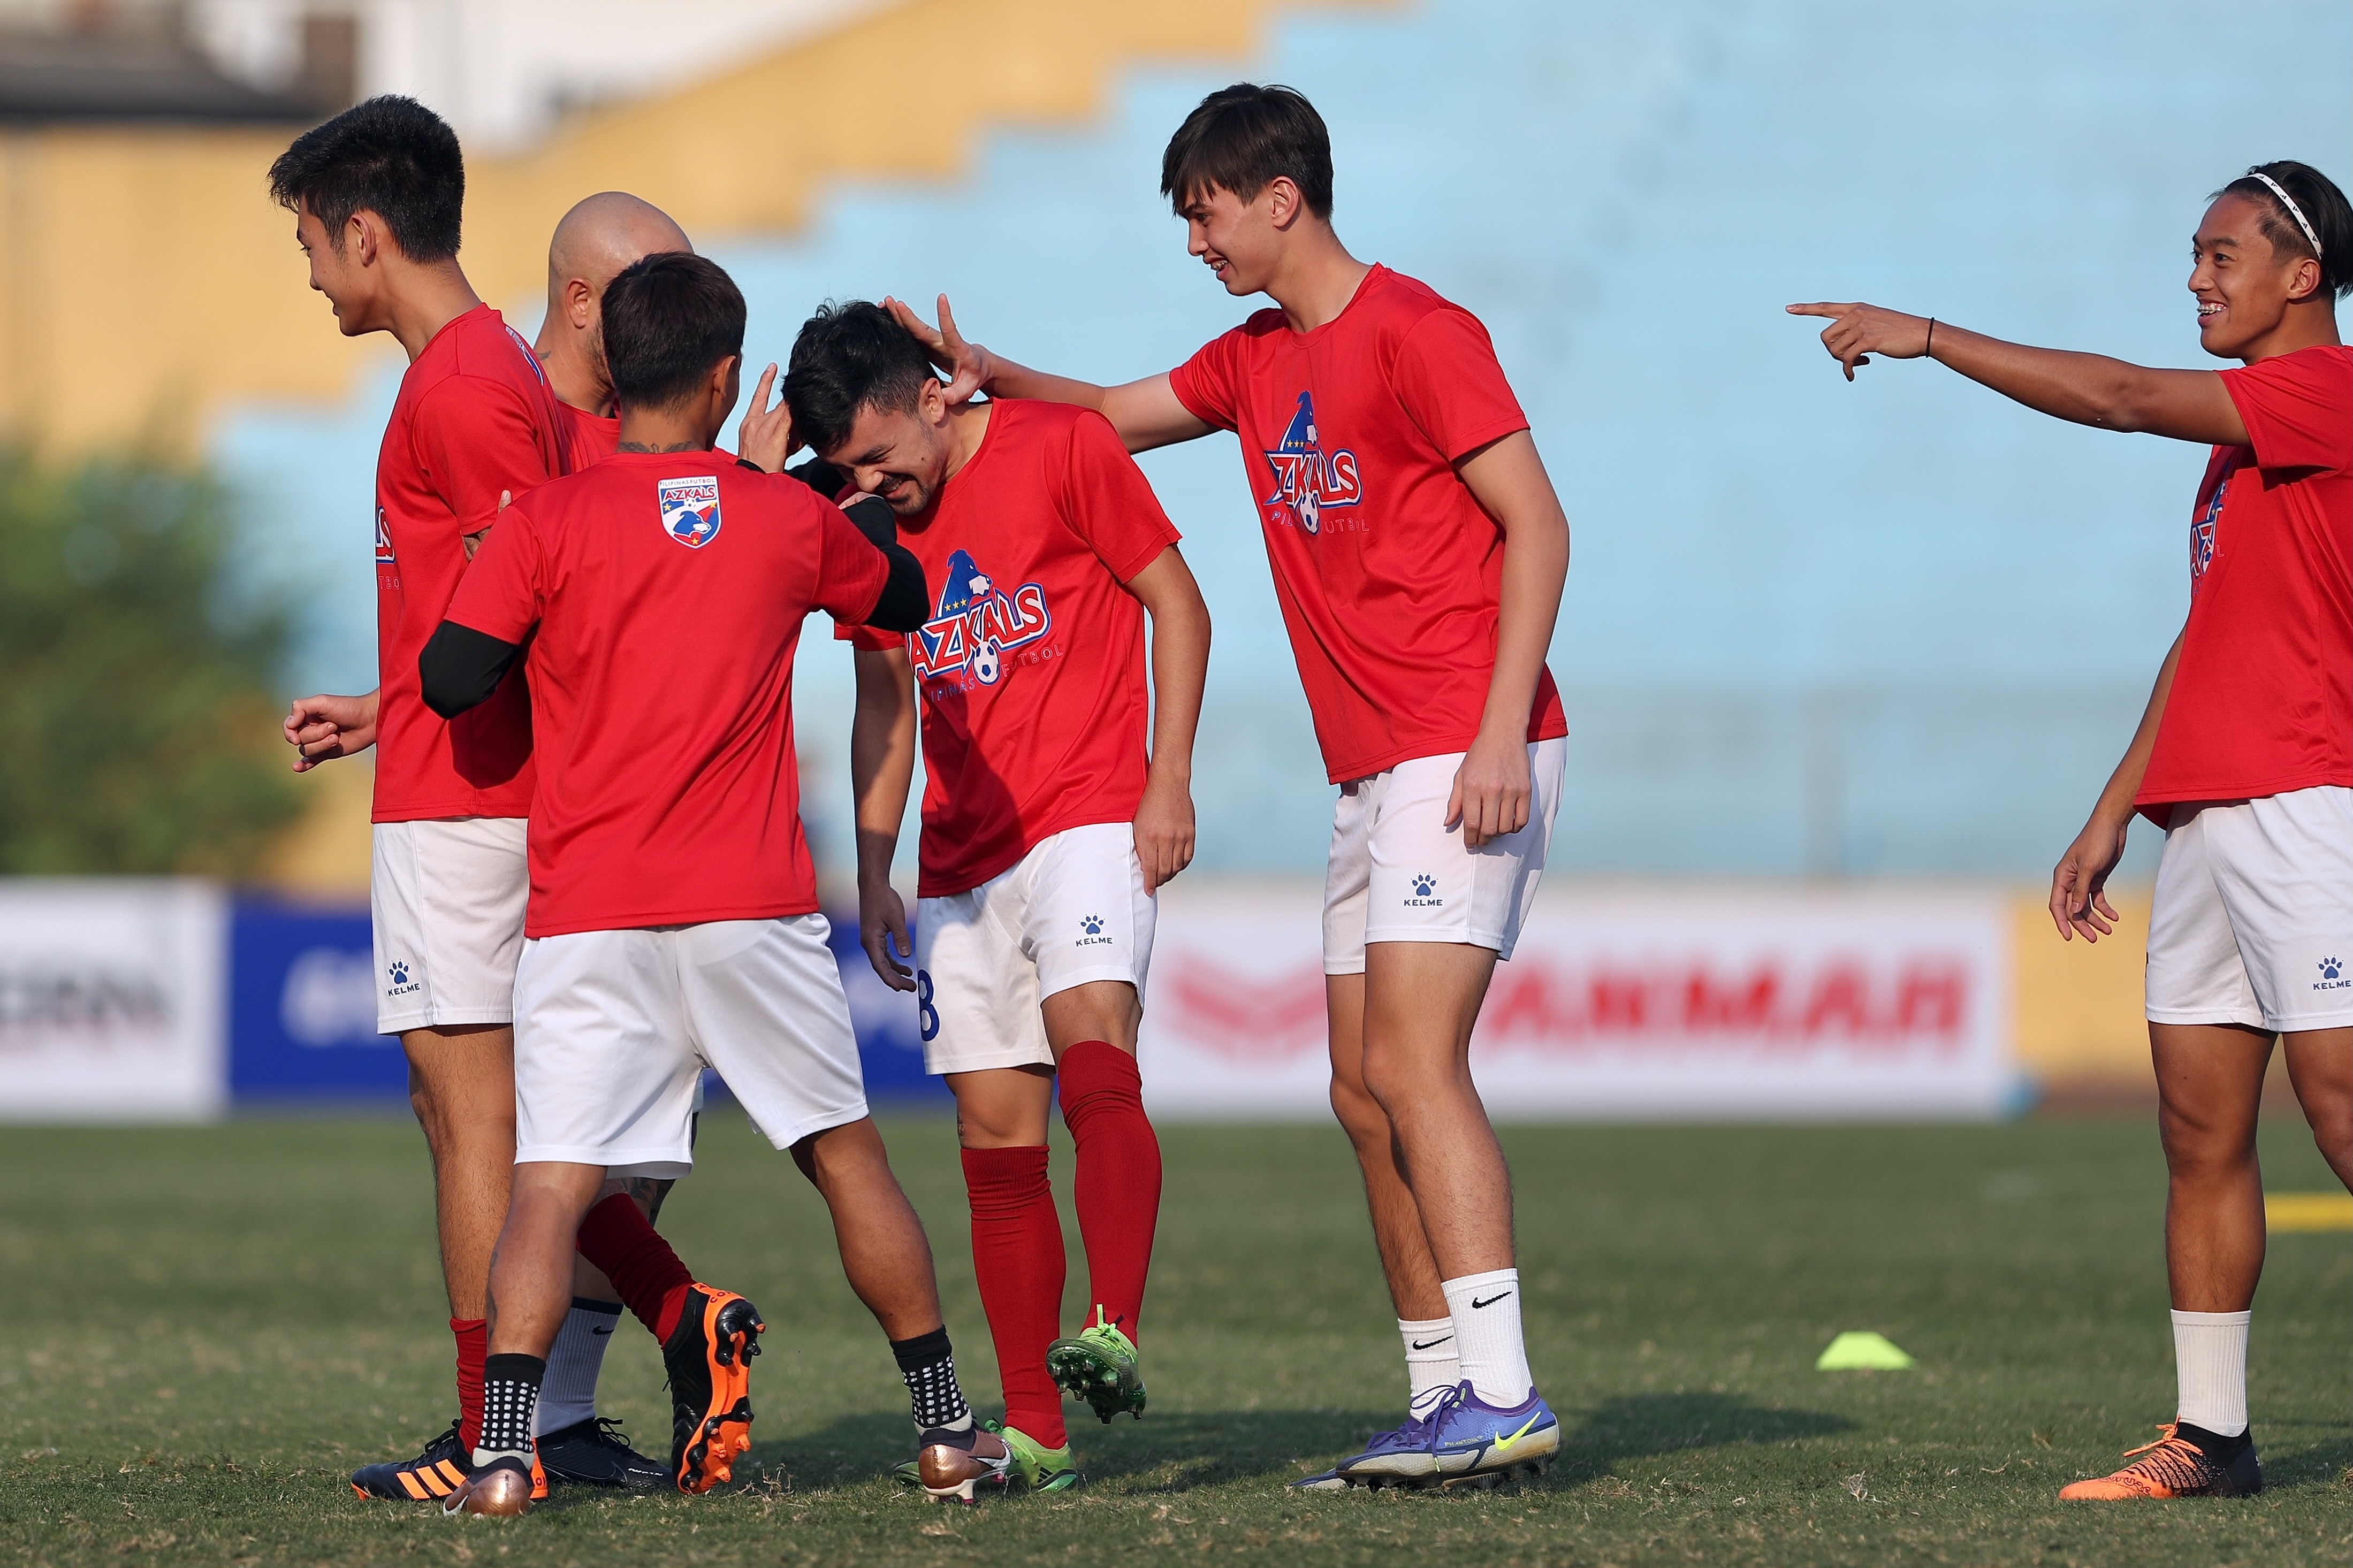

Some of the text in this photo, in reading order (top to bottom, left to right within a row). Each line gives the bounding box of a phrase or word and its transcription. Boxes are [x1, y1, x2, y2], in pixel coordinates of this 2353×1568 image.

[1268, 450, 1362, 507] ZKALS
[664, 487, 715, 501] AZKALS
[908, 585, 1049, 675] AZKALS
[931, 677, 976, 703] IPINAS
[1075, 937, 1113, 947] KELME
[387, 983, 421, 997] KELME
[2312, 980, 2352, 990] KELME
